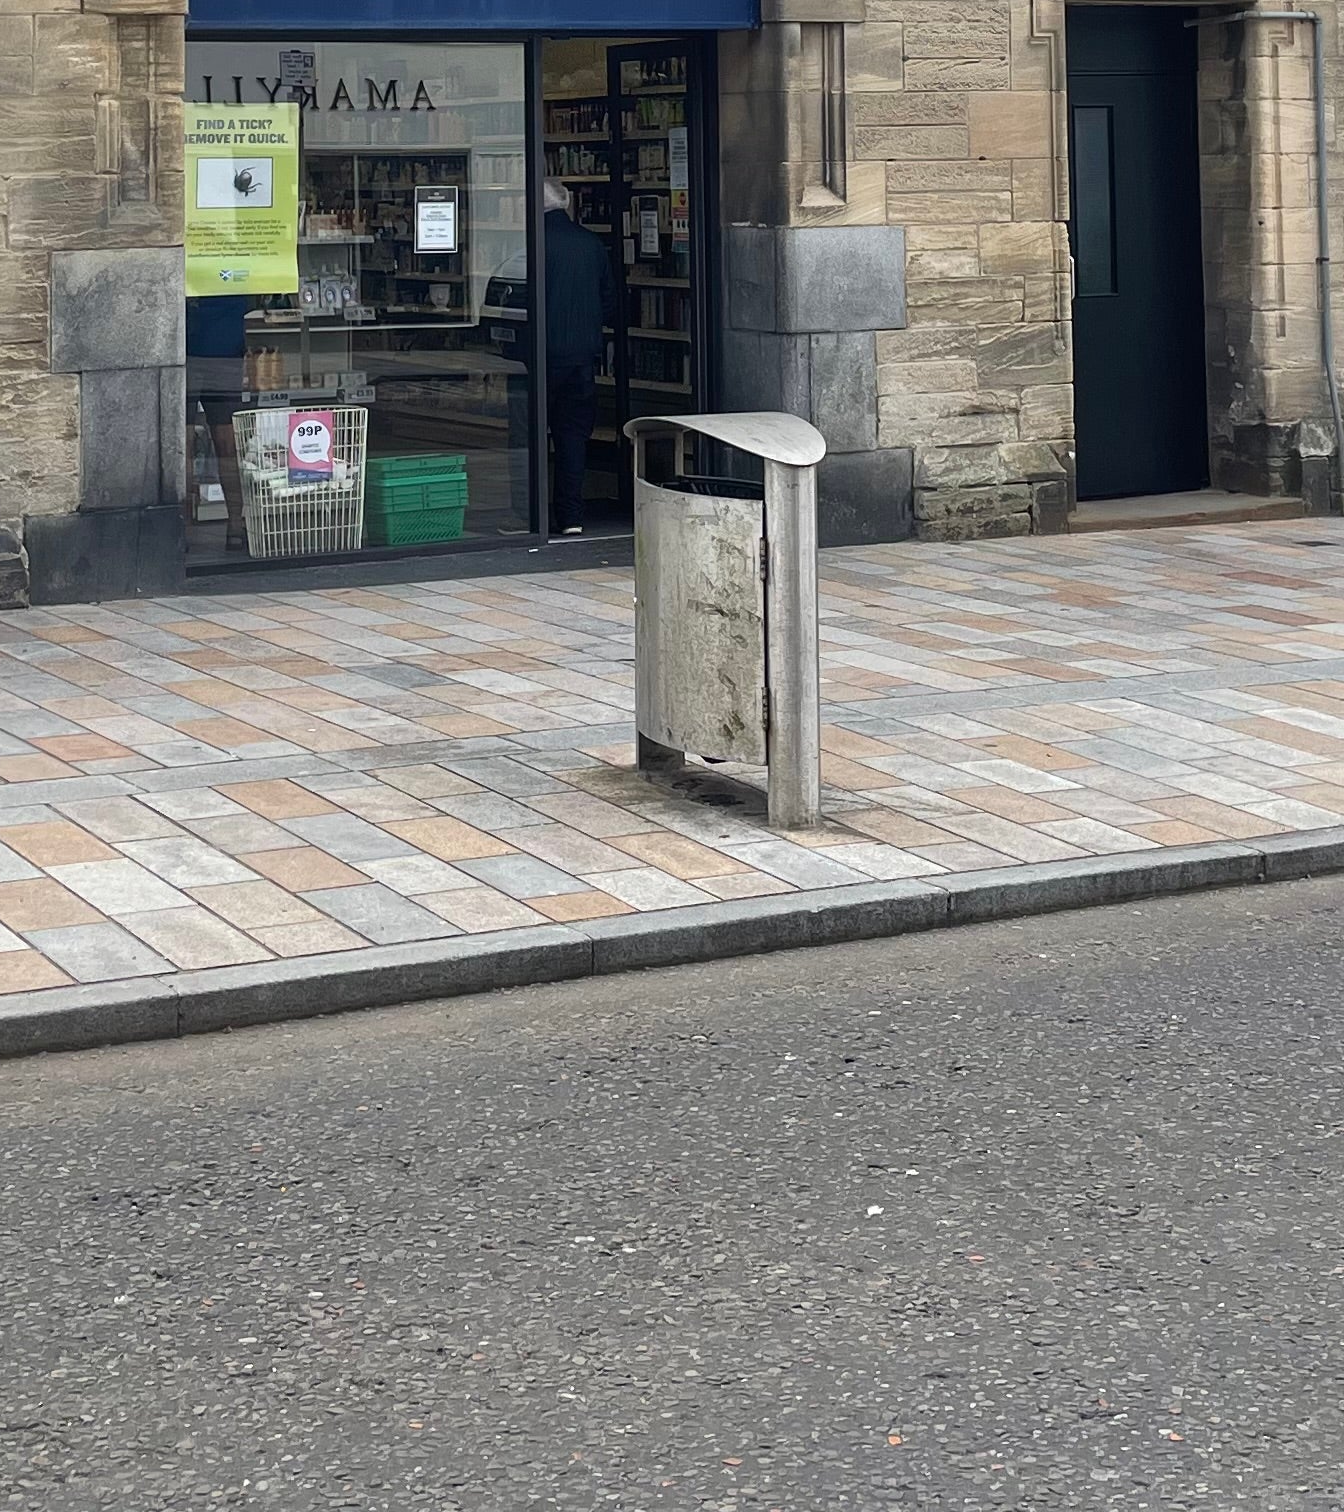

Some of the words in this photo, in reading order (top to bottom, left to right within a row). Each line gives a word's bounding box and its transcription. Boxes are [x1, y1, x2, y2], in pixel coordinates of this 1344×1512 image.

[196, 119, 225, 130] FIND
[228, 120, 236, 130] A
[239, 120, 273, 130] TICK?
[234, 133, 245, 144] IT
[248, 133, 288, 144] QUICK.
[297, 425, 323, 437] 99P
